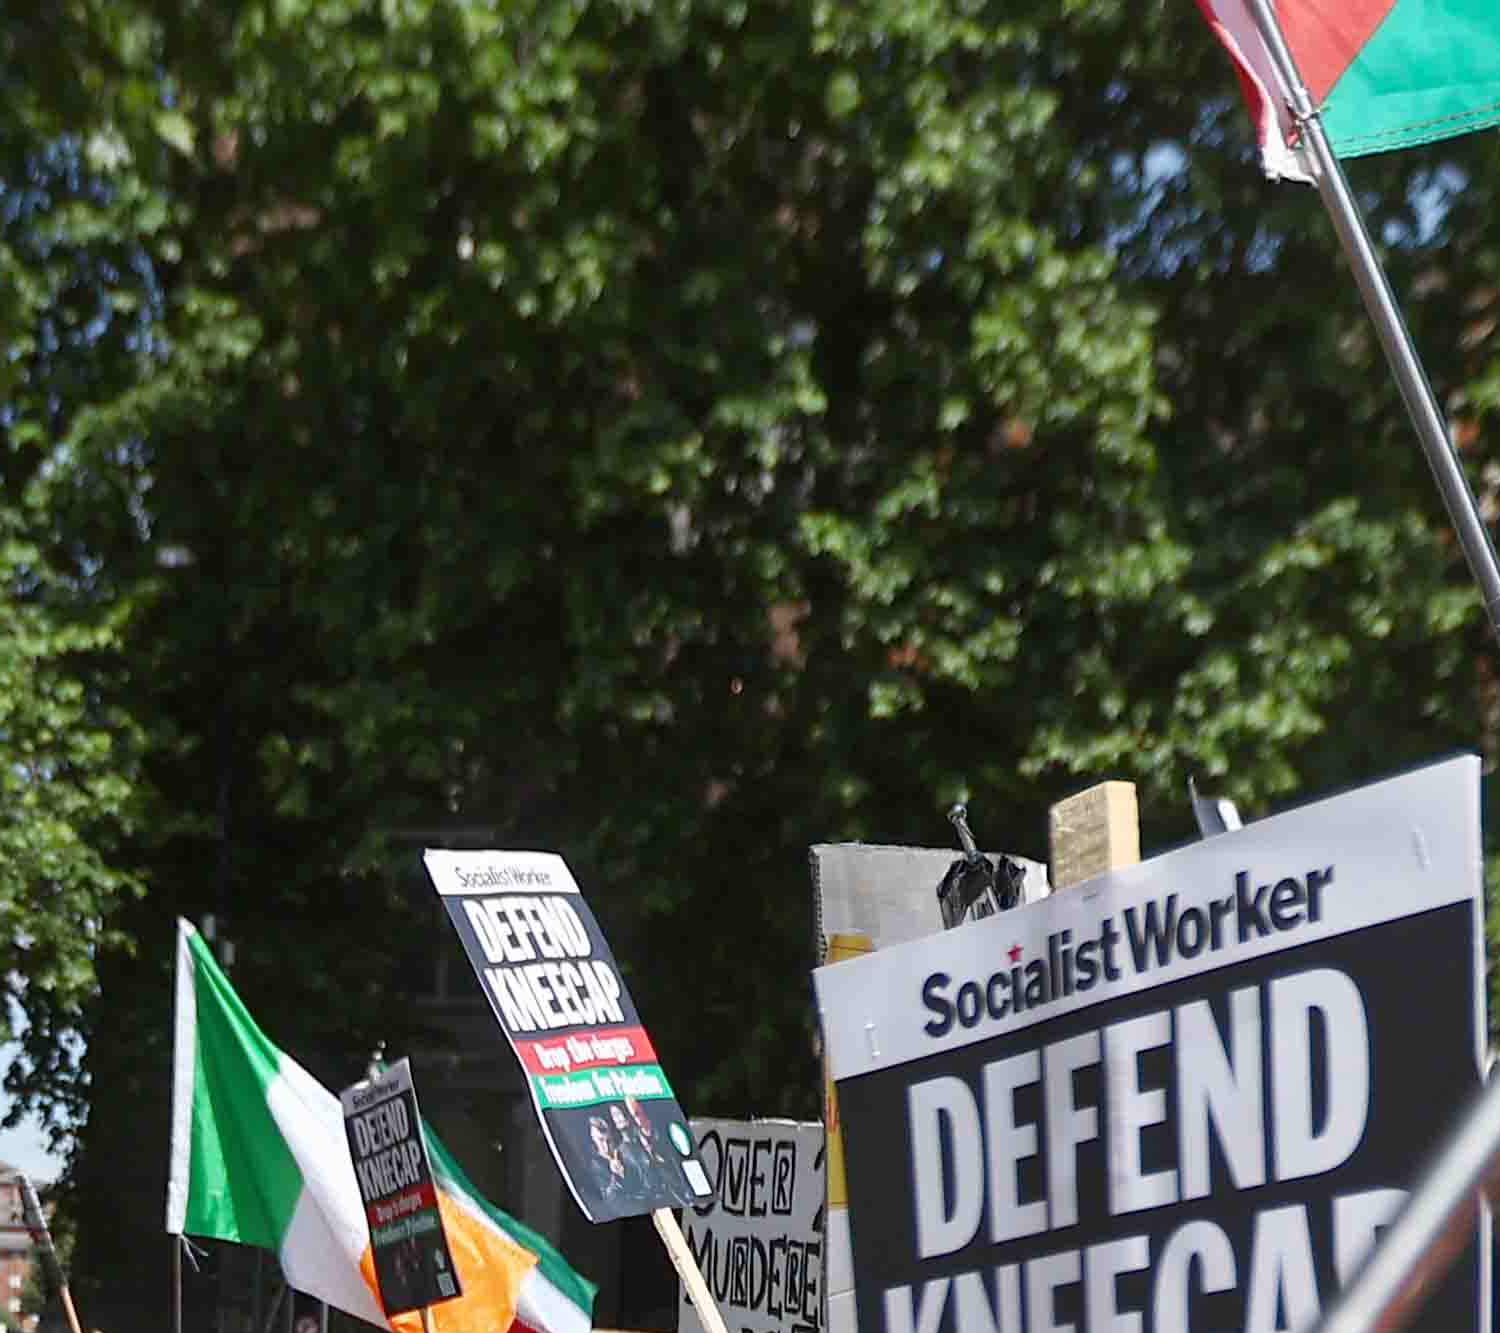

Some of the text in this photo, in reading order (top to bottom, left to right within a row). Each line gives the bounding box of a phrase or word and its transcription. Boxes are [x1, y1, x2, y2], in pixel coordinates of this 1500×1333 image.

[462, 896, 592, 964] DEFEND
[922, 864, 1335, 1039] Socialist Worker
[484, 960, 626, 1033] KNEECAP
[908, 967, 1370, 1261] DEFEND
[685, 1224, 824, 1326] MURDERE
